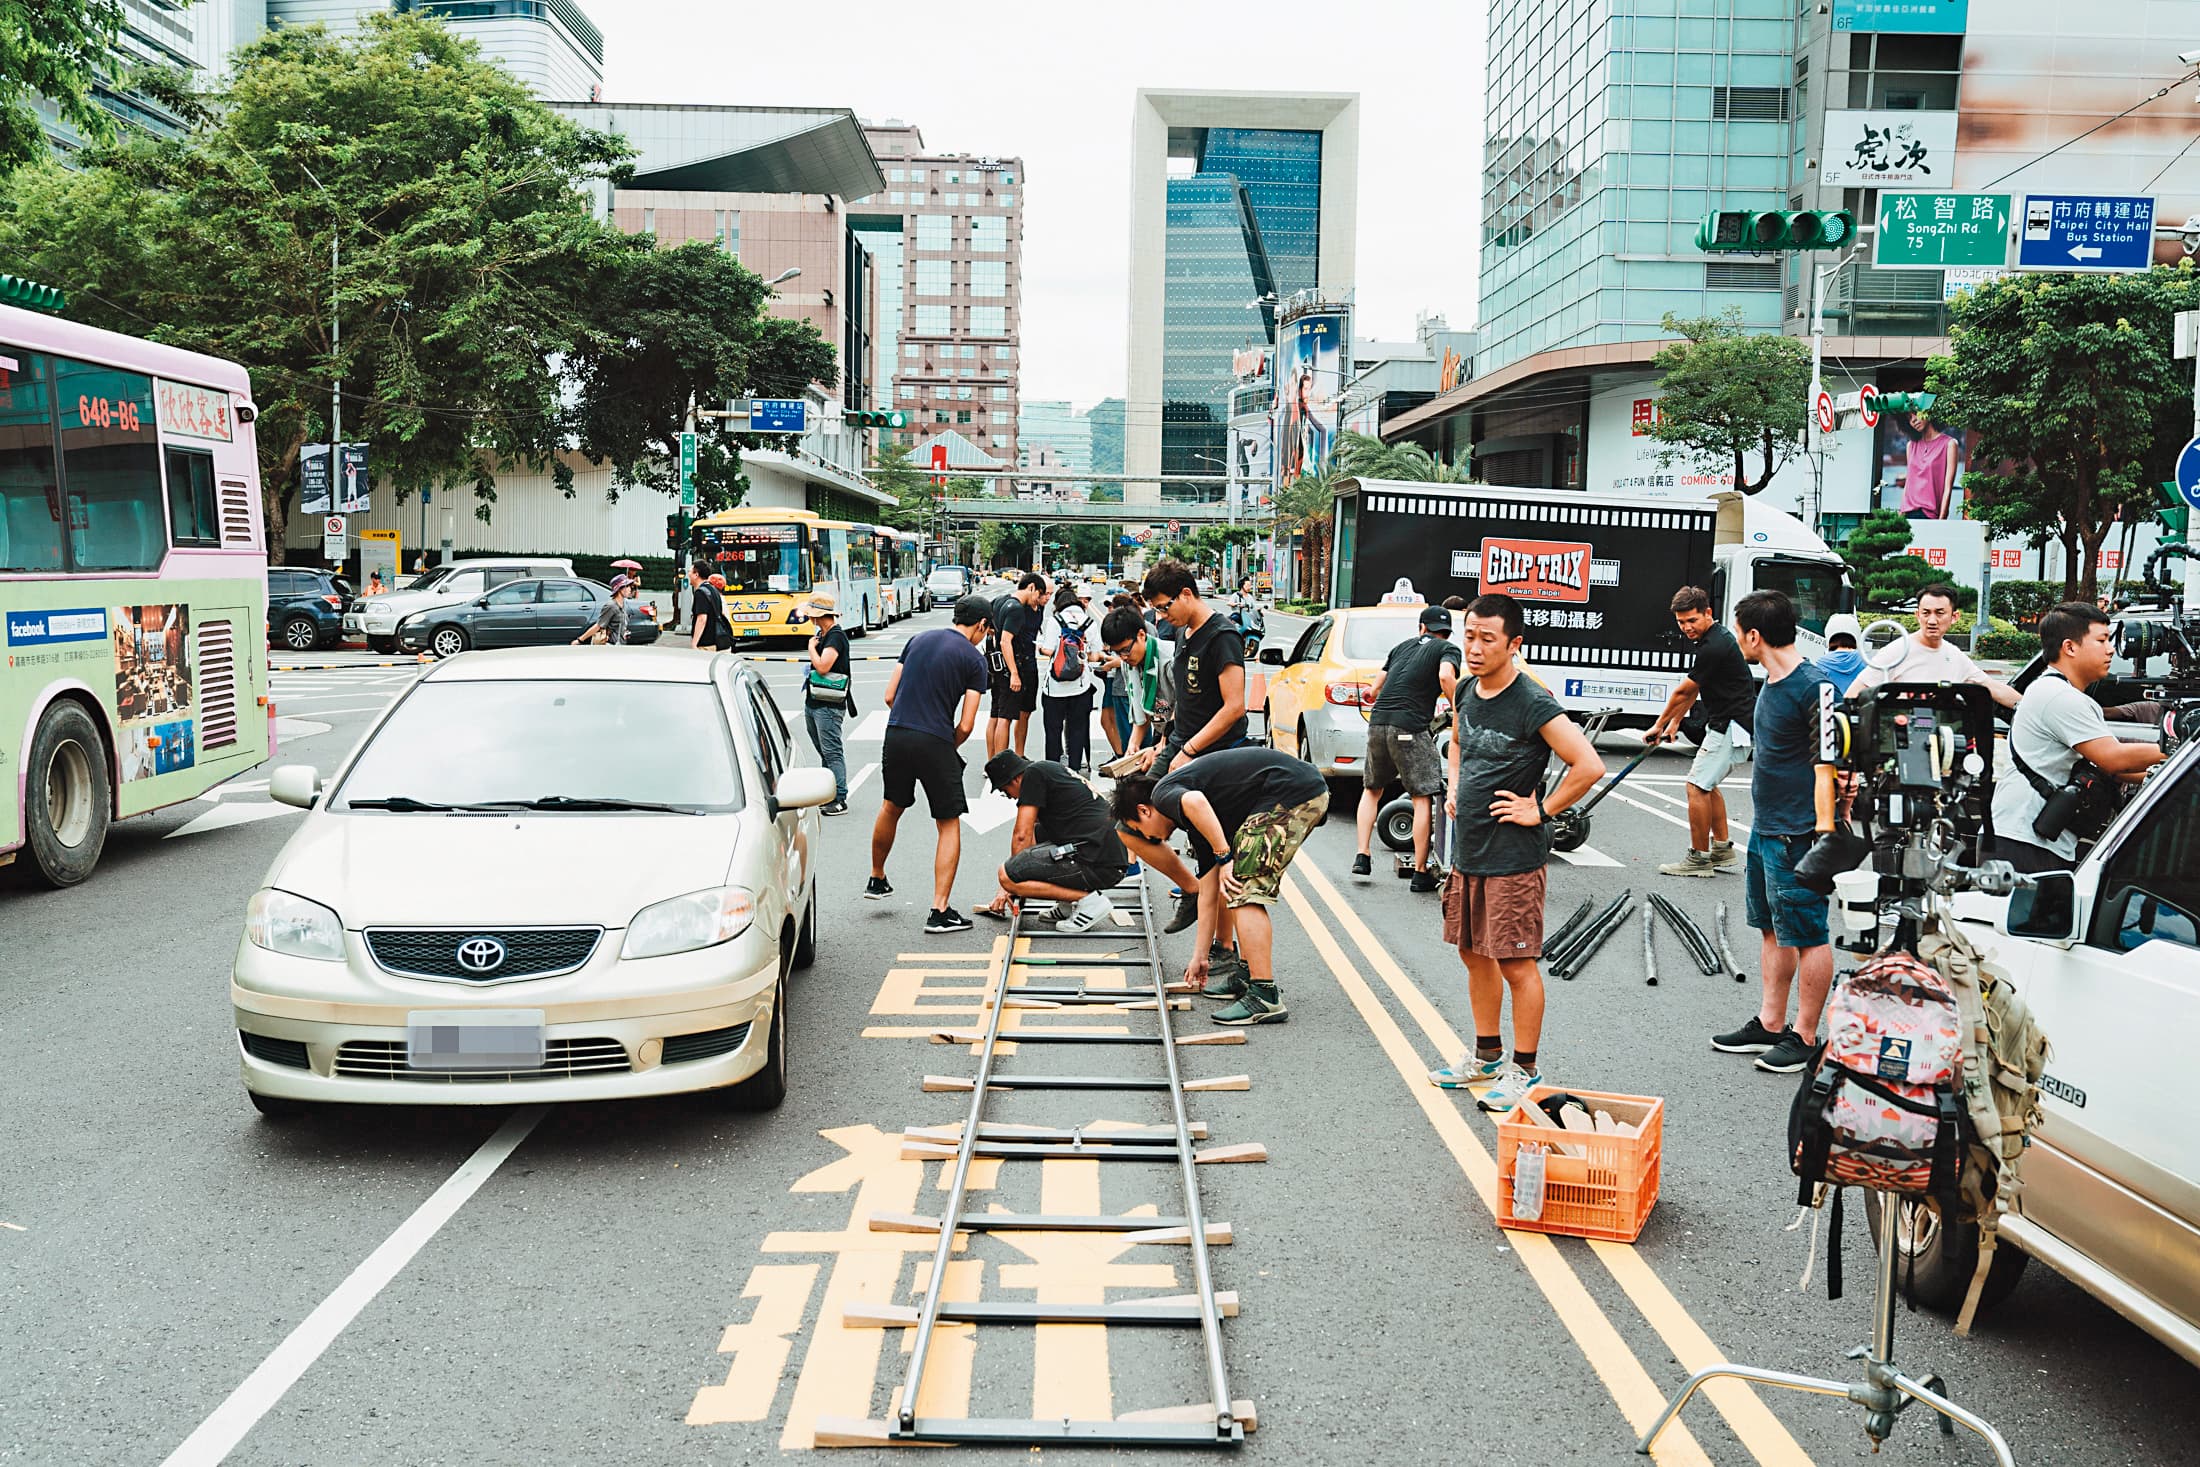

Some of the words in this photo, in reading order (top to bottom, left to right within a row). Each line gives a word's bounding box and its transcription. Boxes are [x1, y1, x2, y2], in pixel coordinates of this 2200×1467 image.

[1837, 17, 1853, 28] 6F
[1825, 172, 1841, 183] 5F
[1895, 196, 1995, 220] 松智路
[2055, 201, 2151, 219] 市府轉運站
[1907, 222, 1958, 236] SongZhi
[2054, 219, 2088, 231] Taipei
[2095, 221, 2119, 232] City
[2126, 221, 2149, 231] Hall
[1907, 237, 1923, 249] 75
[2067, 232, 2088, 242] Bus
[2093, 232, 2133, 243] Station
[79, 395, 140, 432] 648-BG
[160, 384, 230, 439] 欣欣客運
[1647, 475, 1674, 487] 信義店
[1681, 475, 1716, 485] COMING
[1486, 545, 1534, 584] GRIP
[1536, 549, 1585, 590] TRIX
[1506, 586, 1532, 595] Taiwan
[1538, 587, 1560, 597] Taipei
[11, 620, 46, 637] facebook
